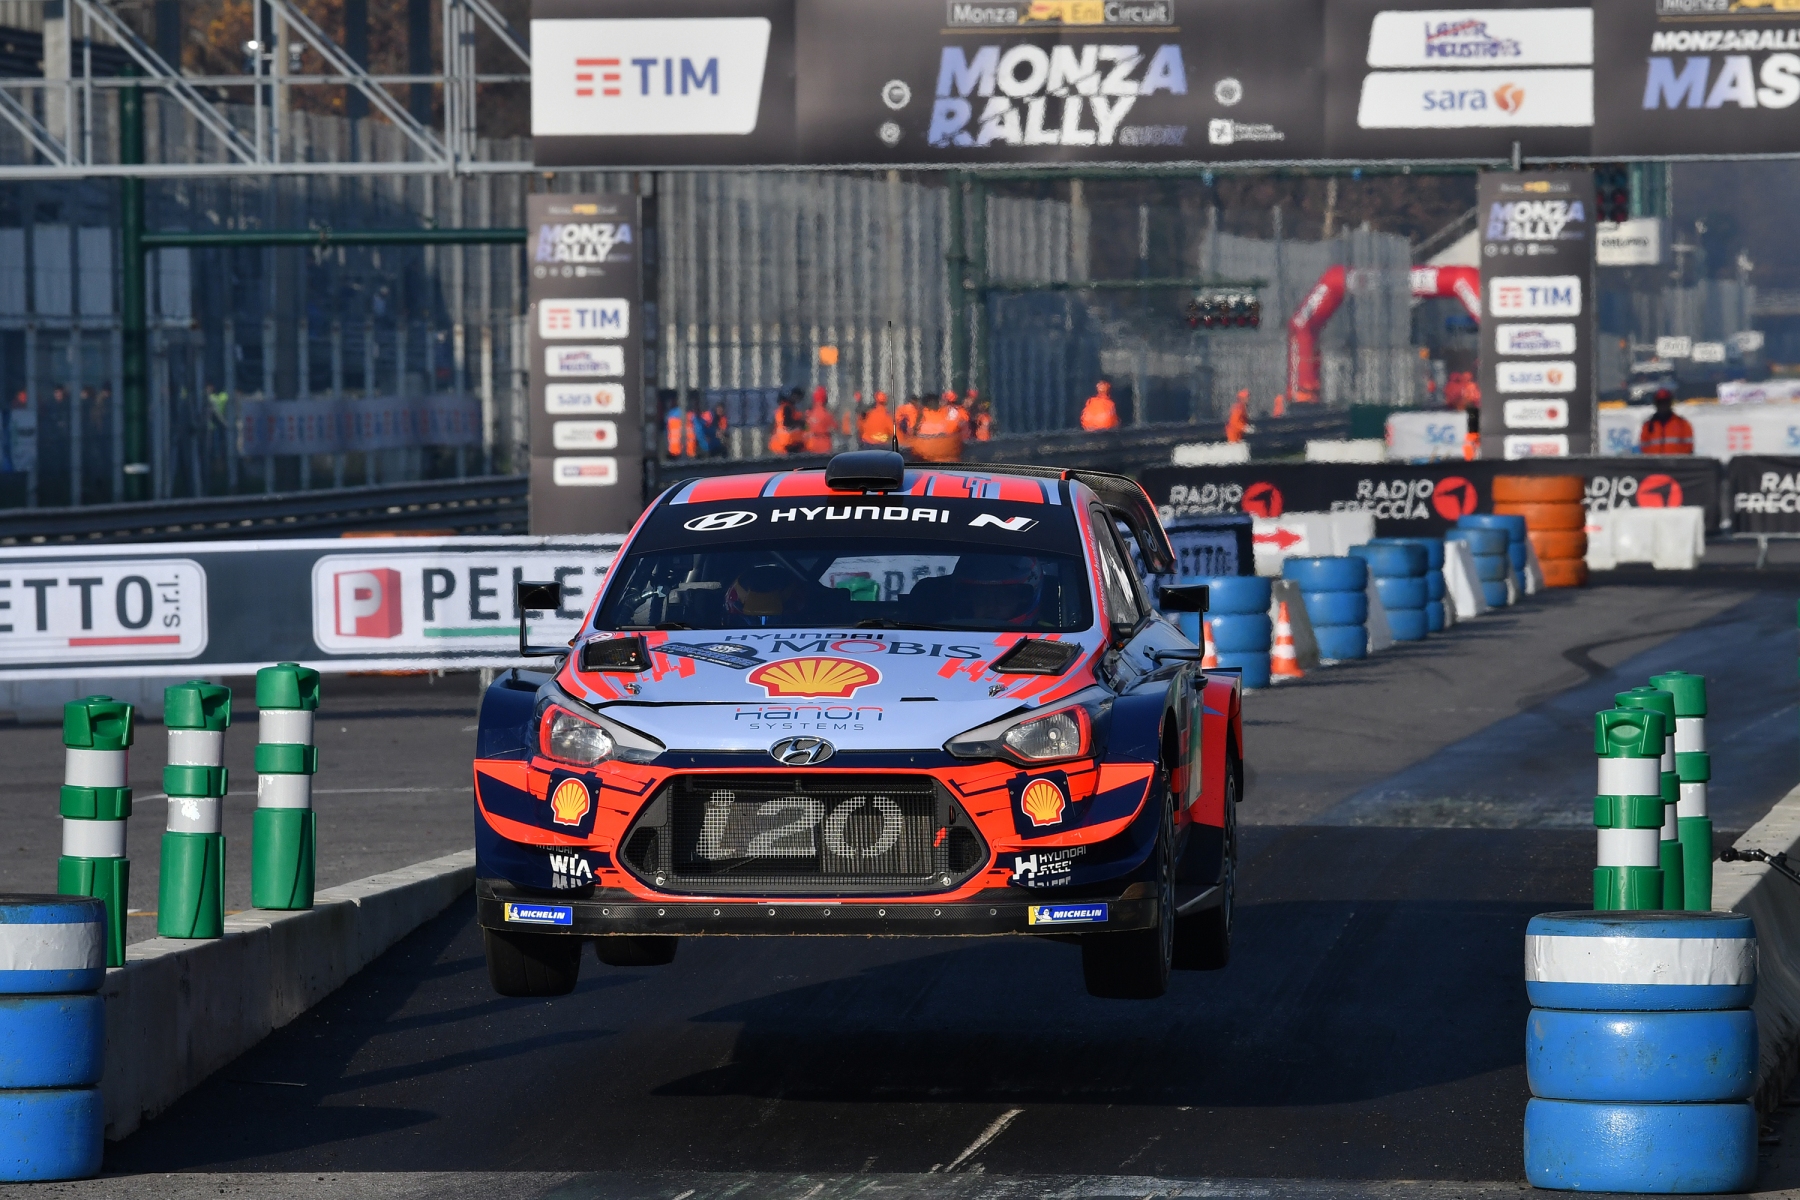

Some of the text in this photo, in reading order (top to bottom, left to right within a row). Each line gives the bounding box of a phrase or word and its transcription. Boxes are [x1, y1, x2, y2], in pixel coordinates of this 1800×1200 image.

[953, 4, 1017, 23] Monza
[1104, 3, 1168, 22] Circuit
[1651, 29, 1800, 52] MONZARALL
[631, 58, 719, 96] TIM
[935, 44, 1188, 98] MONZA
[1642, 53, 1800, 109] MAS
[1423, 89, 1488, 111] sara
[927, 97, 1137, 148] RALLY
[1489, 200, 1586, 222] MONZA
[539, 223, 633, 244] MONZA
[1487, 220, 1567, 241] RALLY
[536, 243, 613, 263] RALLY
[1527, 286, 1572, 307] TIM
[576, 308, 621, 329] TIM
[1170, 483, 1243, 504] RADIO
[1357, 479, 1434, 500] RADIO
[770, 506, 950, 524] HYUNDAI
[157, 573, 181, 628] s.r.l.
[422, 566, 607, 623] PELE
[725, 633, 885, 642] HYUNDAI
[770, 639, 983, 660] MOBIS
[750, 722, 866, 731] SYSTEMS
[1039, 845, 1087, 864] HYUNDAI
[549, 853, 593, 879] WIA
[520, 909, 566, 920] MICHELIN
[1053, 909, 1102, 919] MICHELIN
